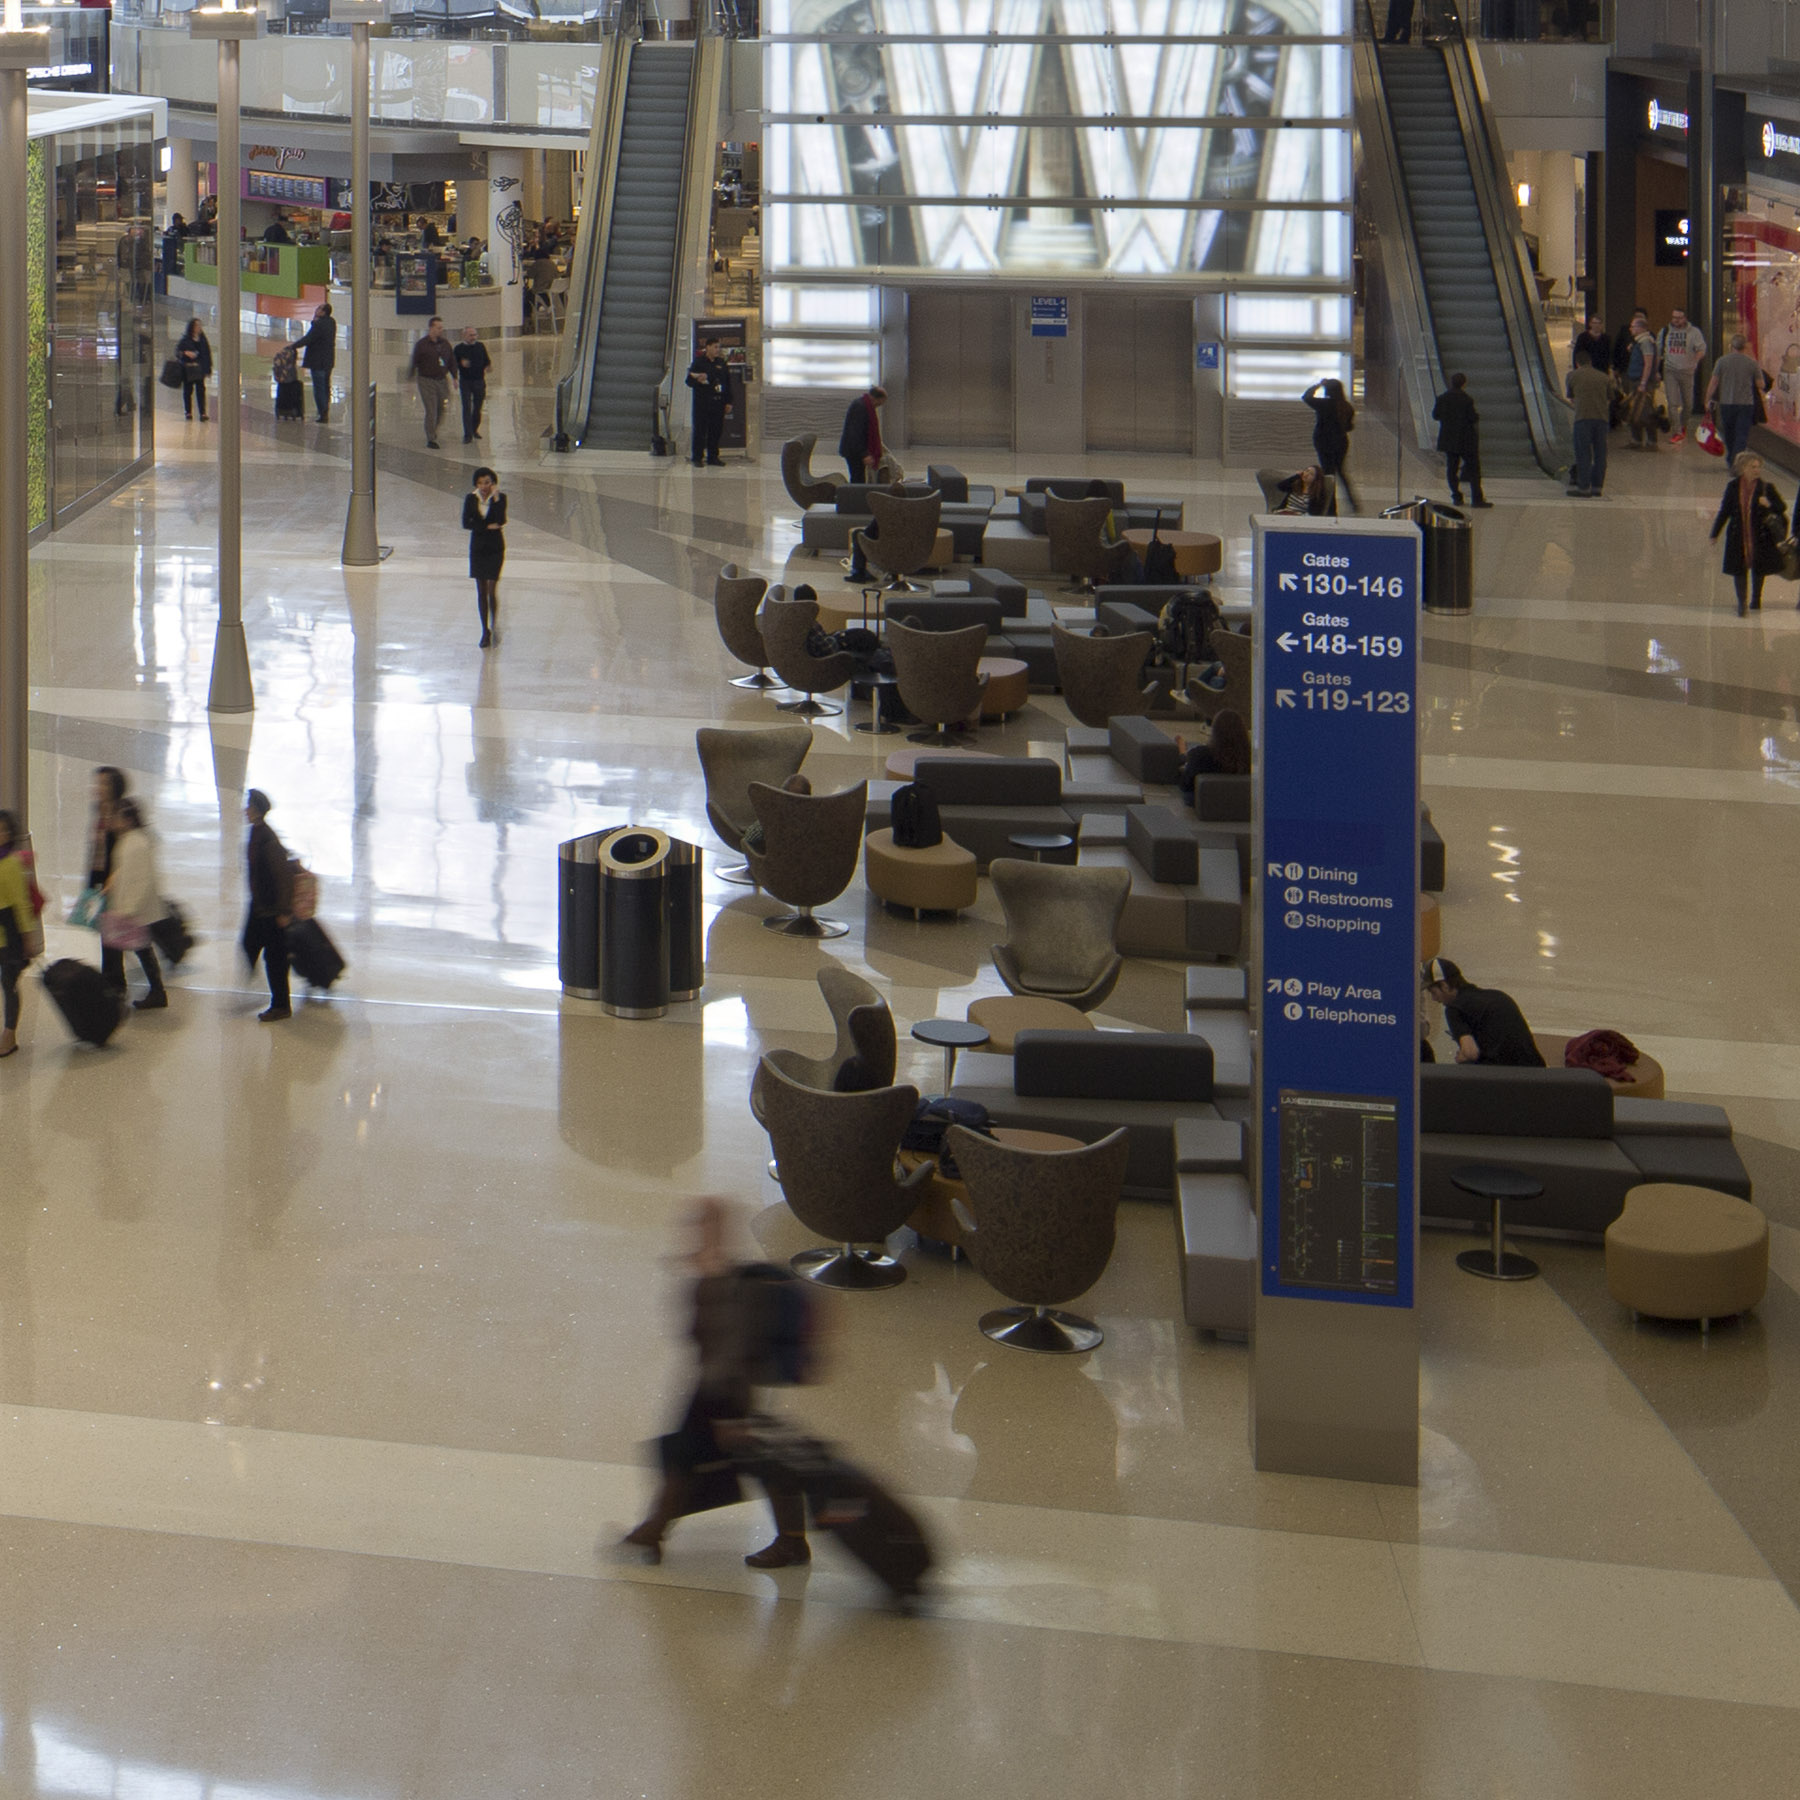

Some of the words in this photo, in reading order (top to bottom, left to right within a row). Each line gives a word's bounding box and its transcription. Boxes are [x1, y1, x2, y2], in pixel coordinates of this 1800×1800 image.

[1302, 553, 1350, 568] Gates
[1302, 574, 1403, 598] 130-146
[1302, 612, 1349, 627] Gates
[1302, 633, 1403, 658] 148-159
[1302, 671, 1351, 685] Gates
[1302, 688, 1410, 714] 119-123
[1308, 866, 1358, 885] Dining
[1308, 891, 1393, 908] Restrooms
[1306, 914, 1381, 935] Shopping
[1307, 982, 1341, 1000] Play
[1345, 985, 1382, 1000] Area
[1307, 1006, 1396, 1025] Telephones
